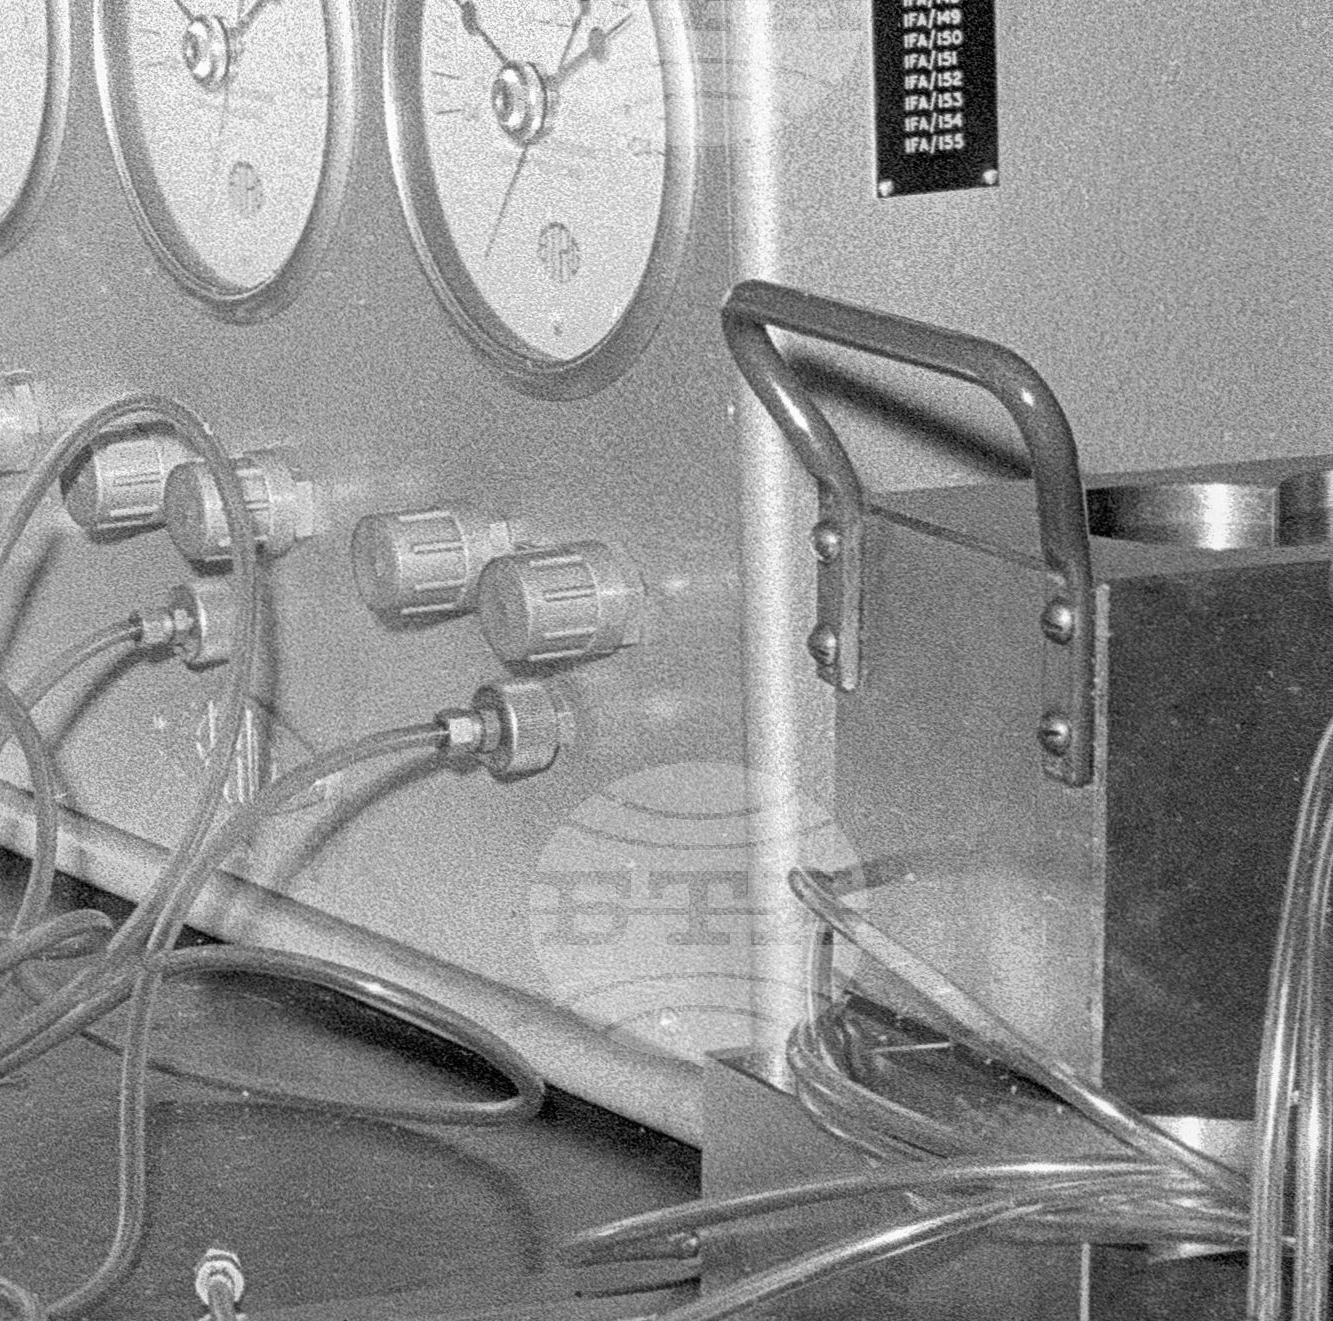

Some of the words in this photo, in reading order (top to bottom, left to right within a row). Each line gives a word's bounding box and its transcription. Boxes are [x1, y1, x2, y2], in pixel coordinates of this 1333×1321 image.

[903, 8, 962, 29] IFA/149
[904, 29, 964, 50] IFA/150
[904, 50, 958, 71] IFA/151
[904, 70, 964, 90] IFA/152
[905, 91, 964, 112] IFA/153
[905, 112, 964, 133] IFA/154
[905, 133, 965, 154] IFA/155
